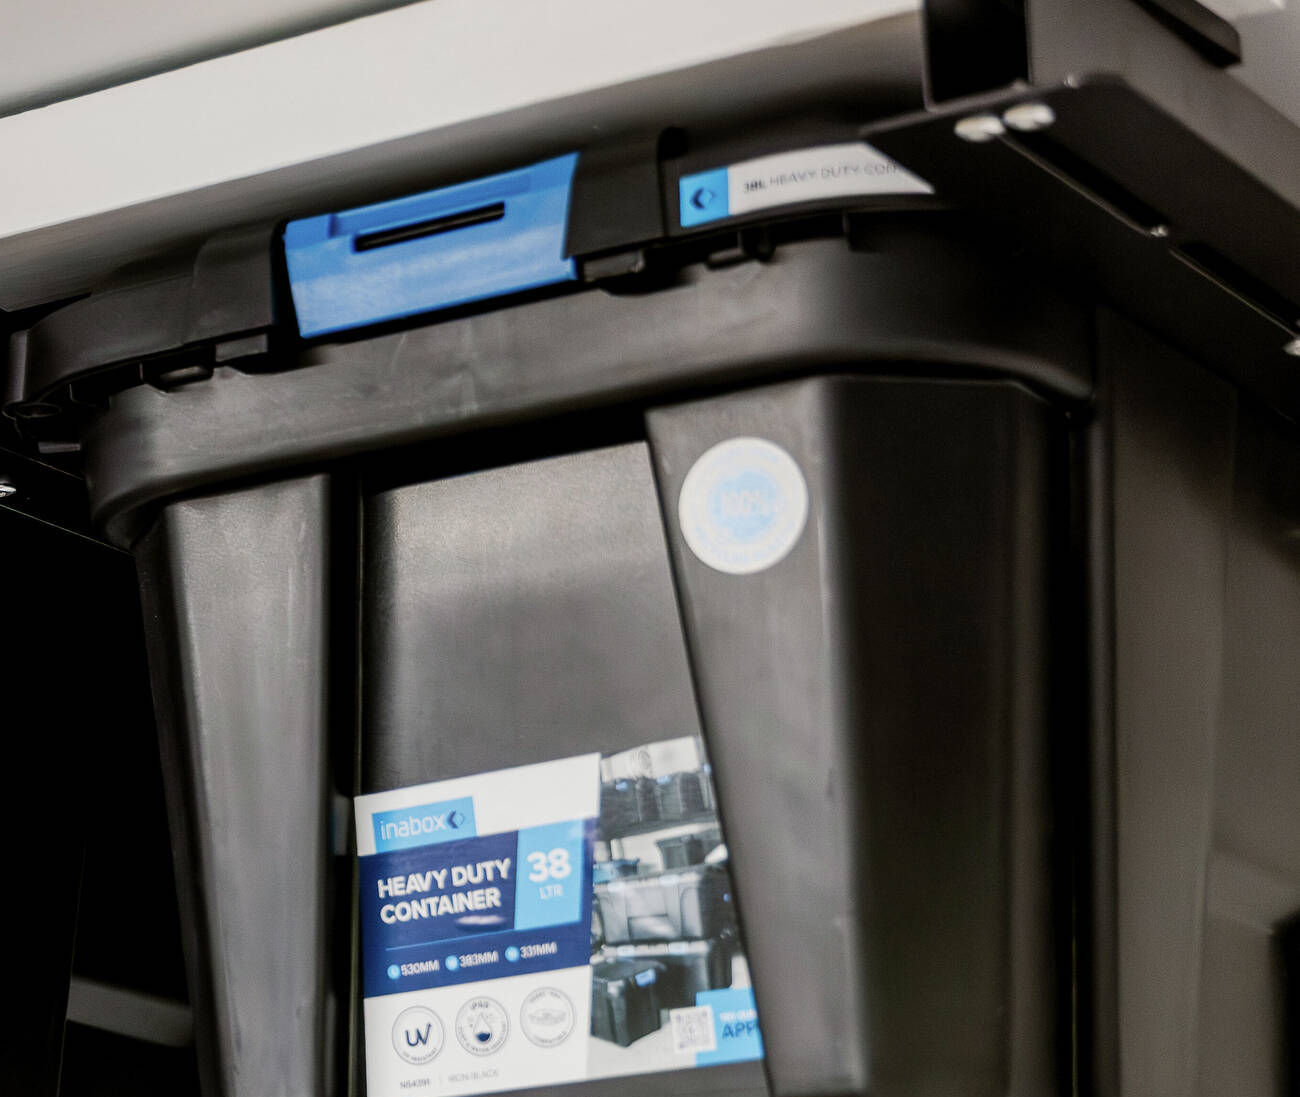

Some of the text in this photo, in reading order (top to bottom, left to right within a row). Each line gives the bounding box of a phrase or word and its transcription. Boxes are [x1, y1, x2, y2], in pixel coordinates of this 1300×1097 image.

[379, 813, 447, 841] inabox
[377, 857, 511, 899] HEAVY DUTY
[527, 848, 572, 883] 38
[380, 887, 502, 925] CONTAINER
